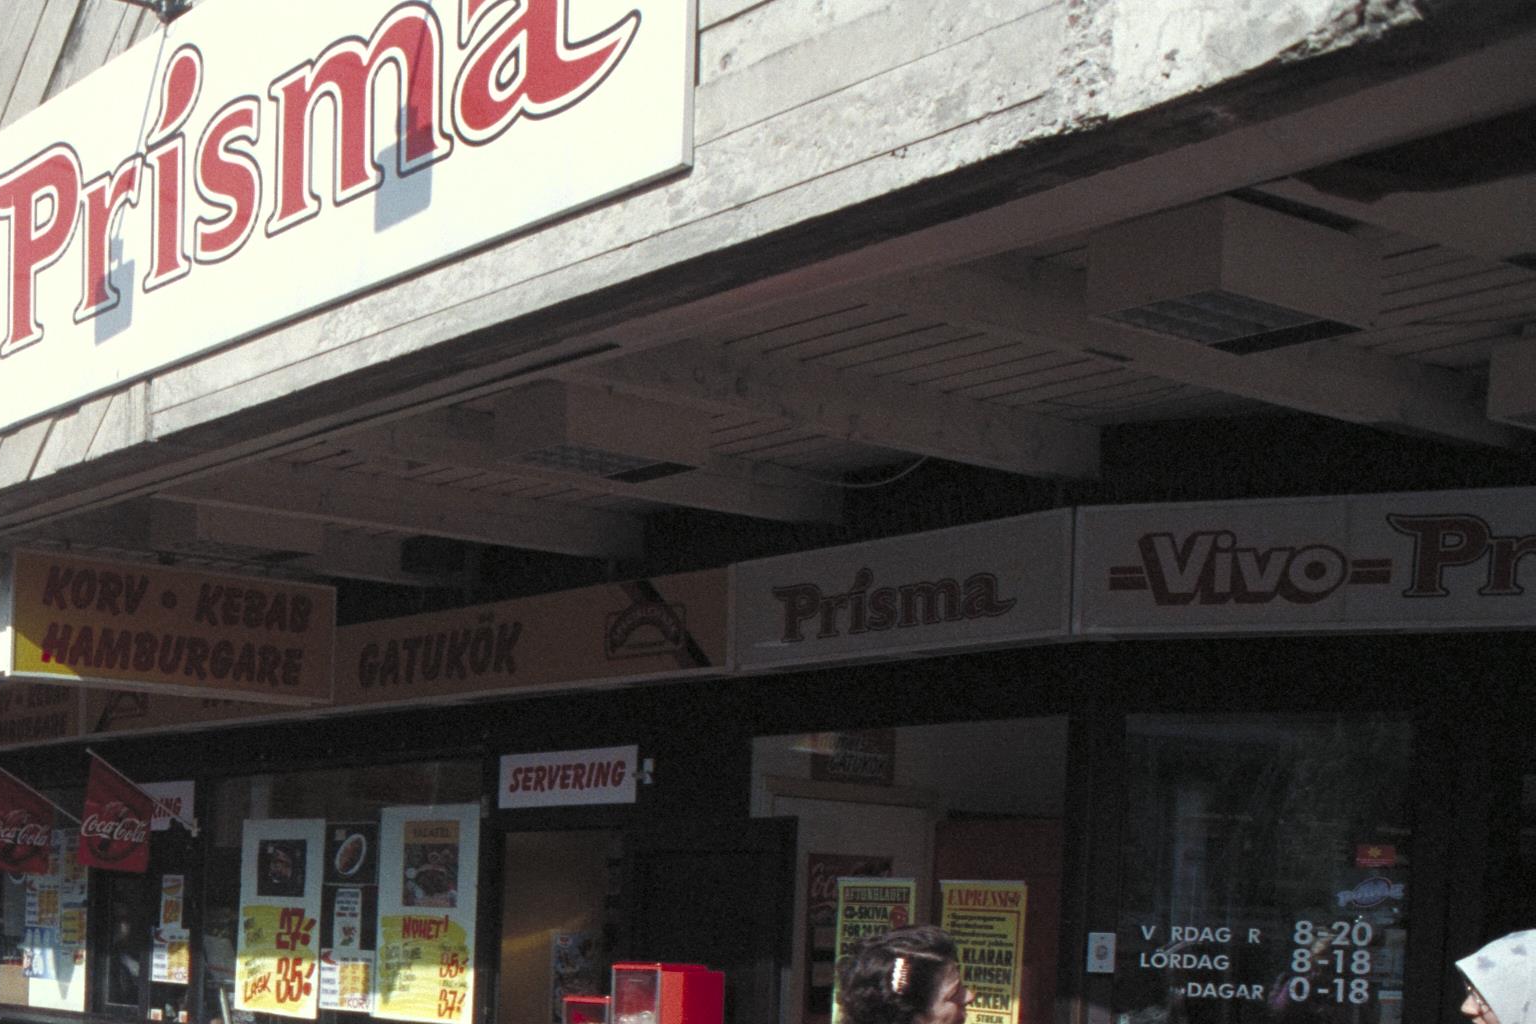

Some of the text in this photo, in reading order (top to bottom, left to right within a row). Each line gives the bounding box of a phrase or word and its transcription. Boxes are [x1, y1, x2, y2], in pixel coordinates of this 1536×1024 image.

[1138, 531, 1348, 606] Vivo
[42, 565, 313, 633] KORV KEBAB
[772, 566, 1017, 643] Prisma
[42, 622, 304, 687] HAMBURGARE
[359, 610, 522, 688] GATUKÖK
[509, 760, 626, 793] SERVERING
[81, 813, 146, 843] Coca-Cola
[1293, 920, 1372, 946] 8-20
[963, 966, 1011, 985] KRISEN
[1139, 948, 1231, 971] LÖRDAG
[970, 992, 1010, 1010] CKEN
